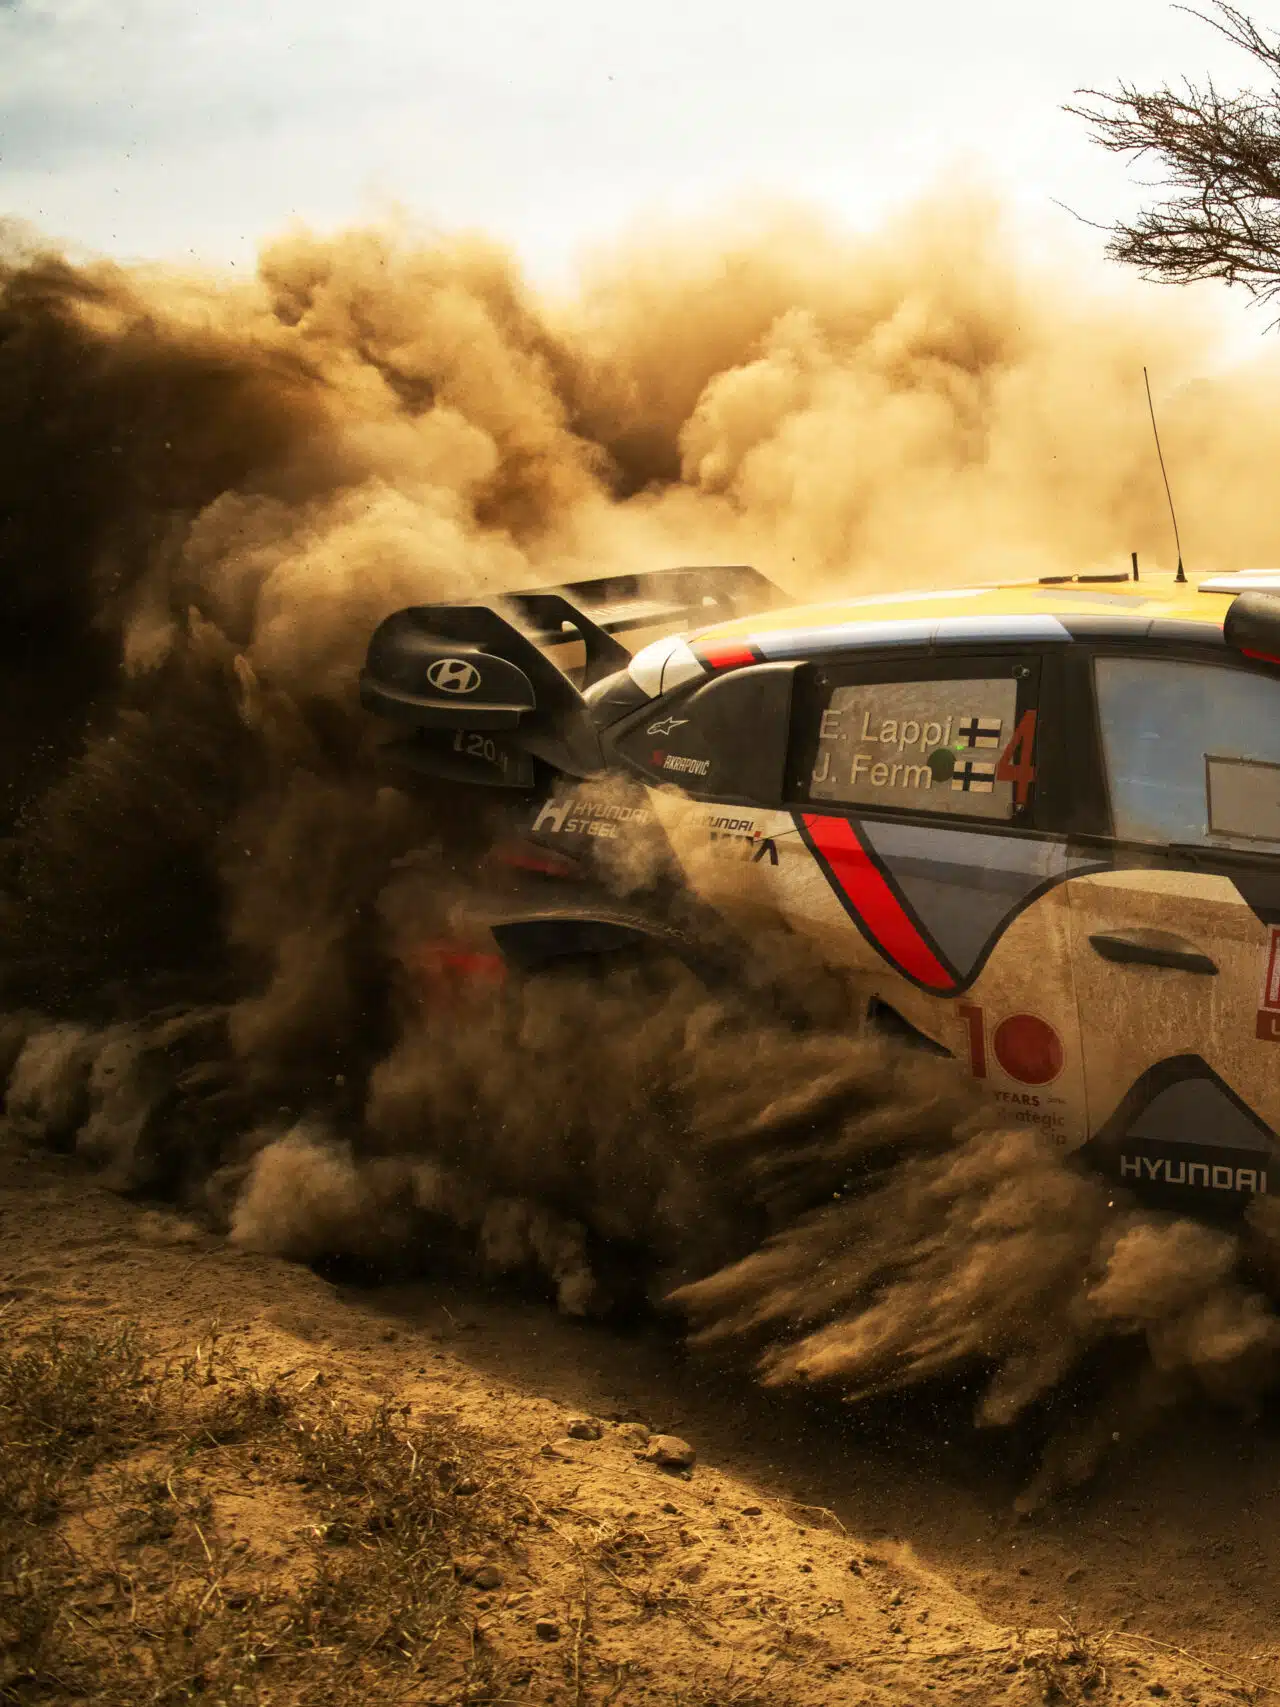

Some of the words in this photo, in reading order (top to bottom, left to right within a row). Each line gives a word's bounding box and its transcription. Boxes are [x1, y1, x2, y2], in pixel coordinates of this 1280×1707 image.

[819, 710, 847, 740] E.
[861, 711, 953, 752] Lappi
[812, 753, 837, 783] J.
[850, 754, 932, 789] Ferm
[997, 709, 1040, 804] 4
[564, 819, 619, 838] STEEL
[571, 802, 648, 823] HYUNDAI
[994, 1090, 1040, 1107] YEARS
[1120, 1154, 1267, 1194] HYUNDAI
